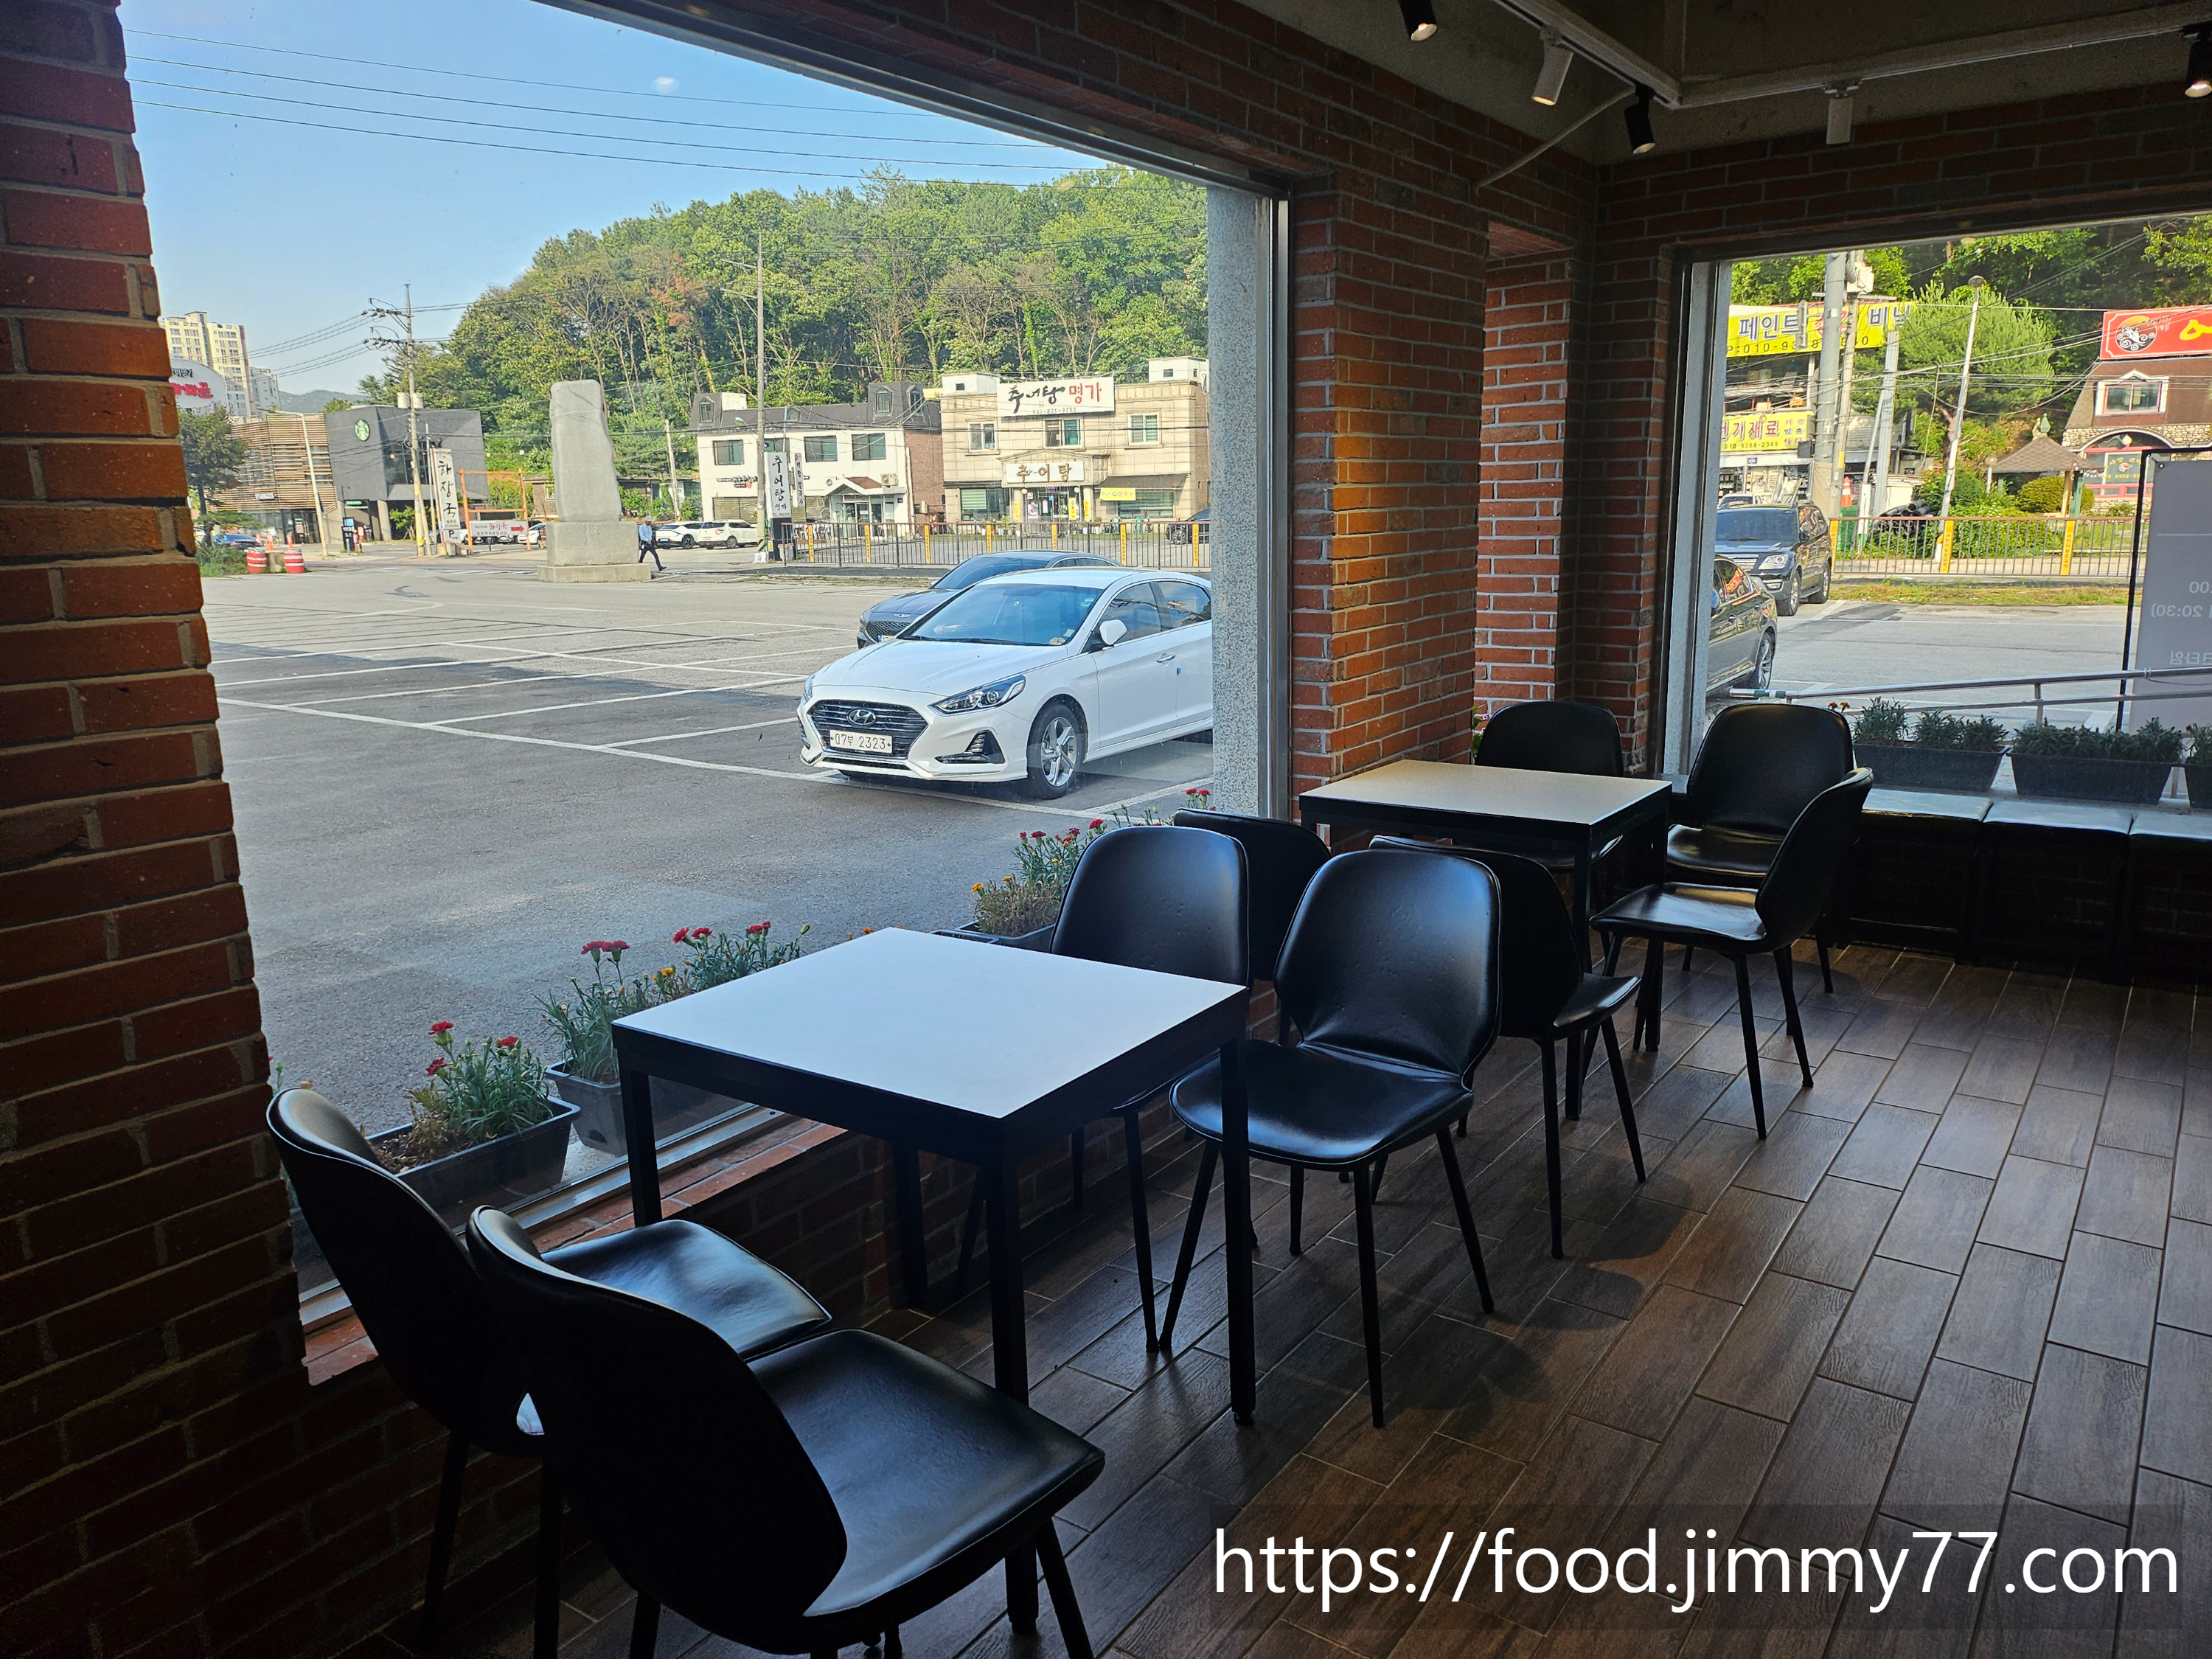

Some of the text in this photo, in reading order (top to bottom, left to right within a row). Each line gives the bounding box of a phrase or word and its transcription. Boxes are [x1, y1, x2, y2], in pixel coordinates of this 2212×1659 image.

[1739, 314, 1802, 340] 페인트
[1008, 382, 1102, 414] 추어탕 명가
[772, 455, 785, 501] 추어탕
[1016, 463, 1072, 482] 추어탕
[438, 460, 457, 518] 해장국
[835, 733, 886, 750] 07부 2323
